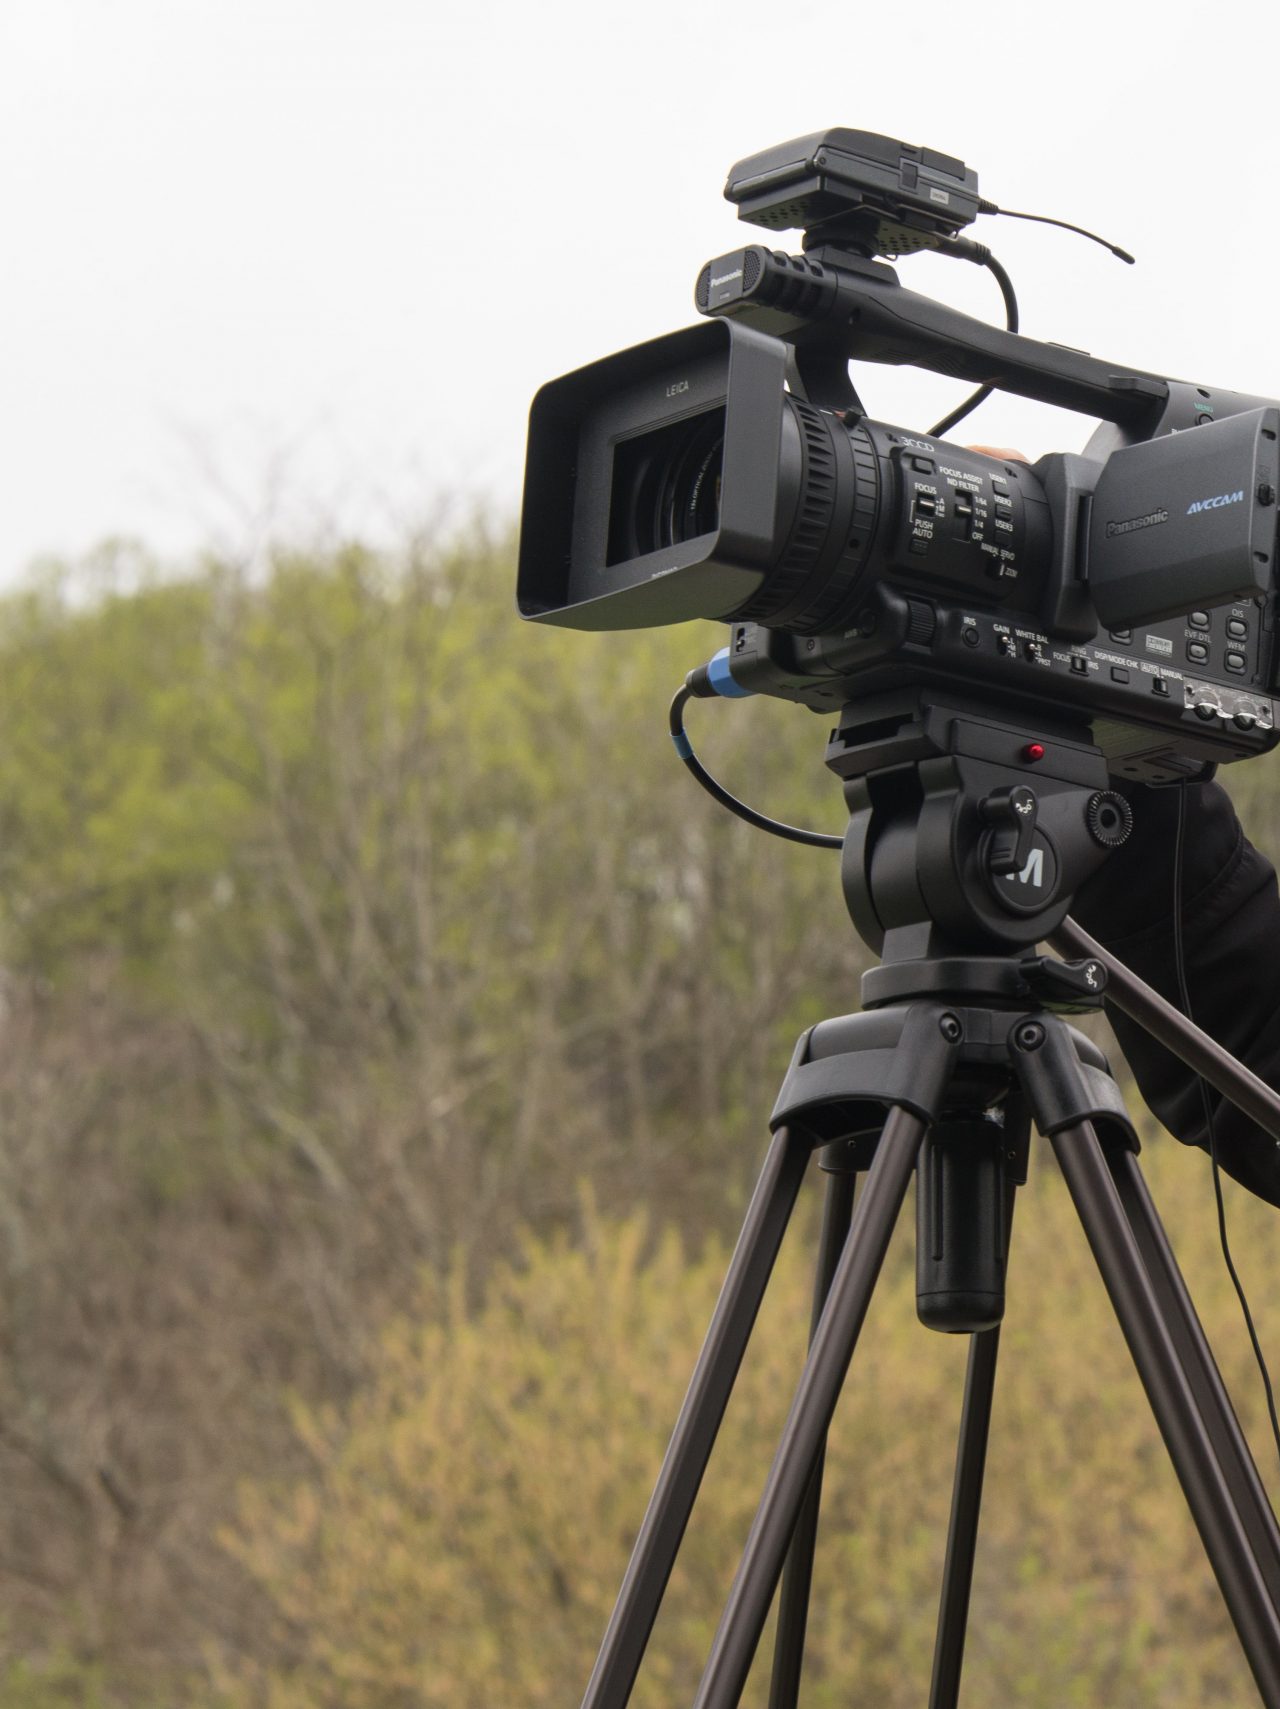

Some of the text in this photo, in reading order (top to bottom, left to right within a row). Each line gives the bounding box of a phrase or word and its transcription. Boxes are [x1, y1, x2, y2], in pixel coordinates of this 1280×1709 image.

[666, 380, 688, 397] LEICA
[900, 437, 934, 452] 3CCD
[939, 466, 983, 485] FOCUS ASSIST
[914, 482, 937, 495] FOCUS
[947, 477, 979, 493] ND FILTER
[1186, 490, 1244, 514] AVCCAM
[915, 519, 934, 530] PUSH
[1106, 508, 1168, 538] Panasonic
[912, 527, 933, 540] AUTO
[972, 531, 984, 541] OFF
[963, 616, 976, 626] IRIS
[993, 623, 1010, 634] GAIN
[1015, 628, 1049, 644] WHITE BAL
[1053, 651, 1071, 662] FOCUS
